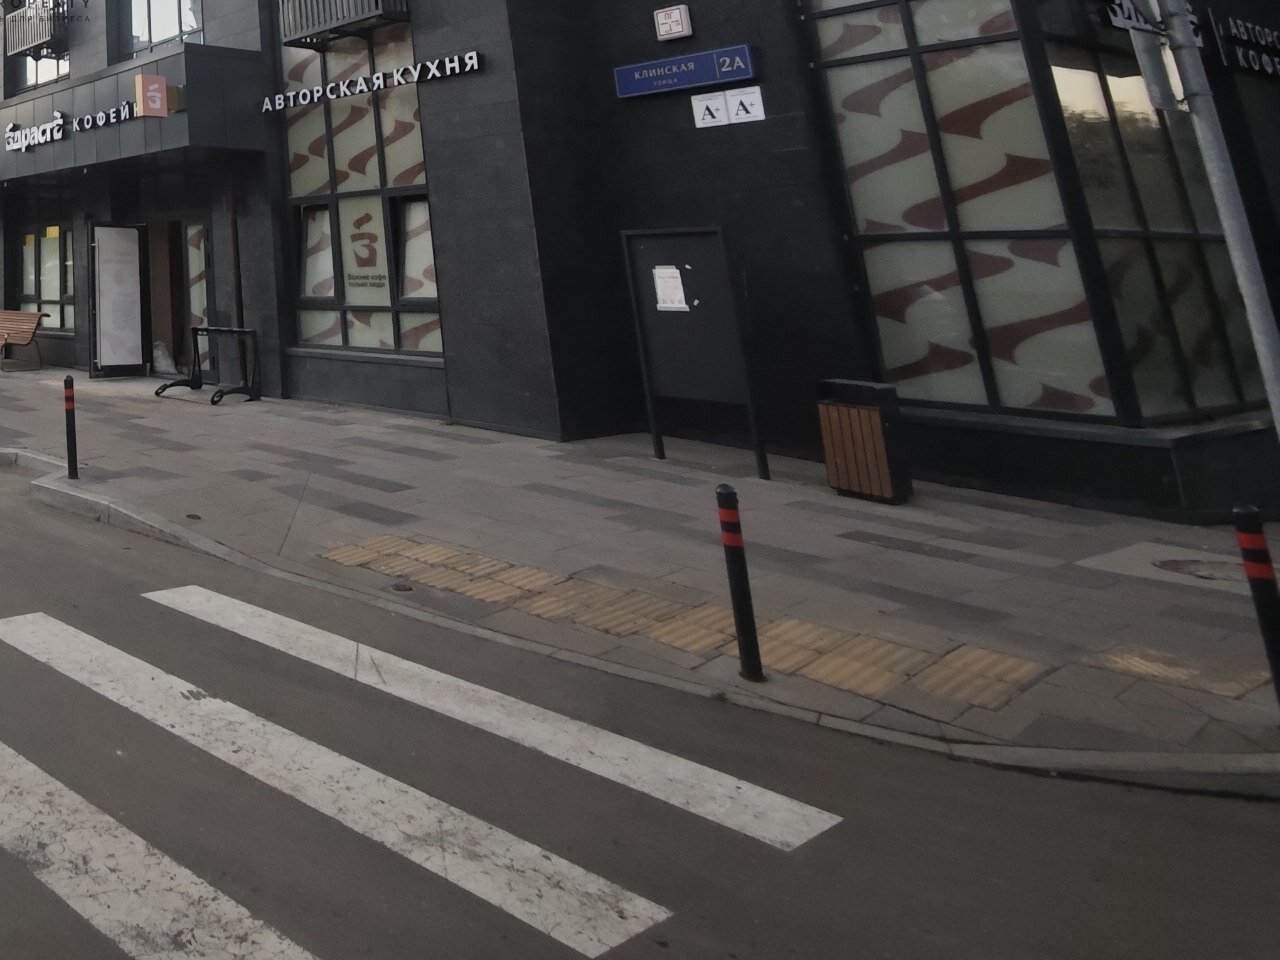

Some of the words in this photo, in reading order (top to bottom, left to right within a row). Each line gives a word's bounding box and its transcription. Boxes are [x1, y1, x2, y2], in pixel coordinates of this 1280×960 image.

[634, 61, 695, 80] КЛИНСКАЯ
[719, 56, 746, 72] 2А
[261, 72, 385, 113] АВТОРСКАЯ
[393, 50, 480, 86] КУХНЯ
[652, 78, 678, 87] УЛИЦА
